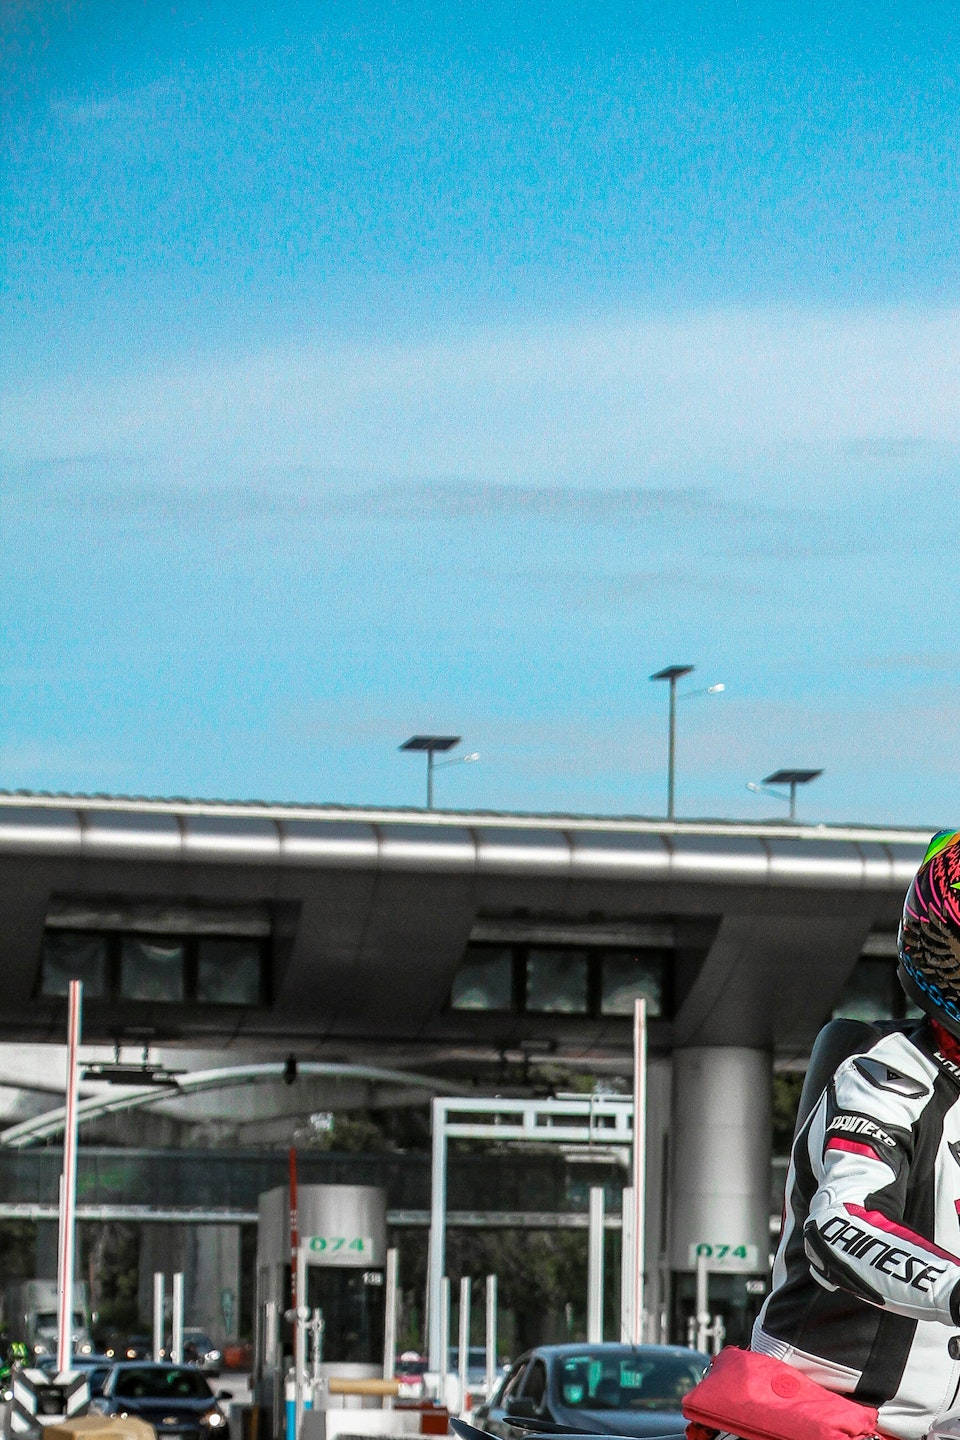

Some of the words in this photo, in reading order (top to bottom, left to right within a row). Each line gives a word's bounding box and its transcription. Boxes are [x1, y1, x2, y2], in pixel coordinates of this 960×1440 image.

[309, 1236, 364, 1252] 074
[696, 1243, 748, 1259] 074
[819, 1216, 947, 1293] DAINESE
